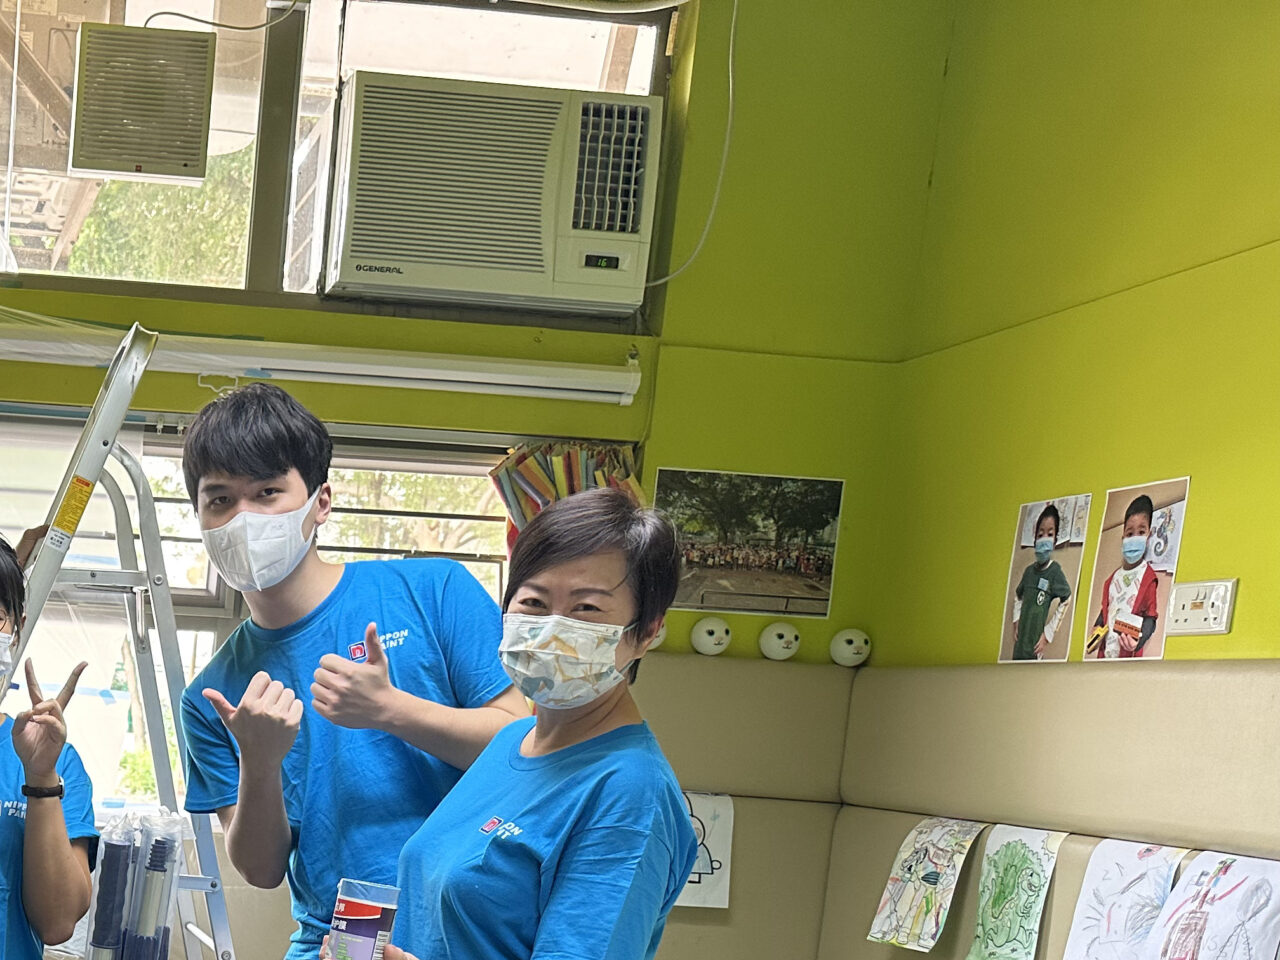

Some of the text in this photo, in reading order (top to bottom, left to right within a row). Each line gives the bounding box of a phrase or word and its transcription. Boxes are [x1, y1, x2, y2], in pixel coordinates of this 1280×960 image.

[379, 629, 409, 643] PPON
[379, 637, 405, 650] AINT
[3, 800, 28, 811] NIPP
